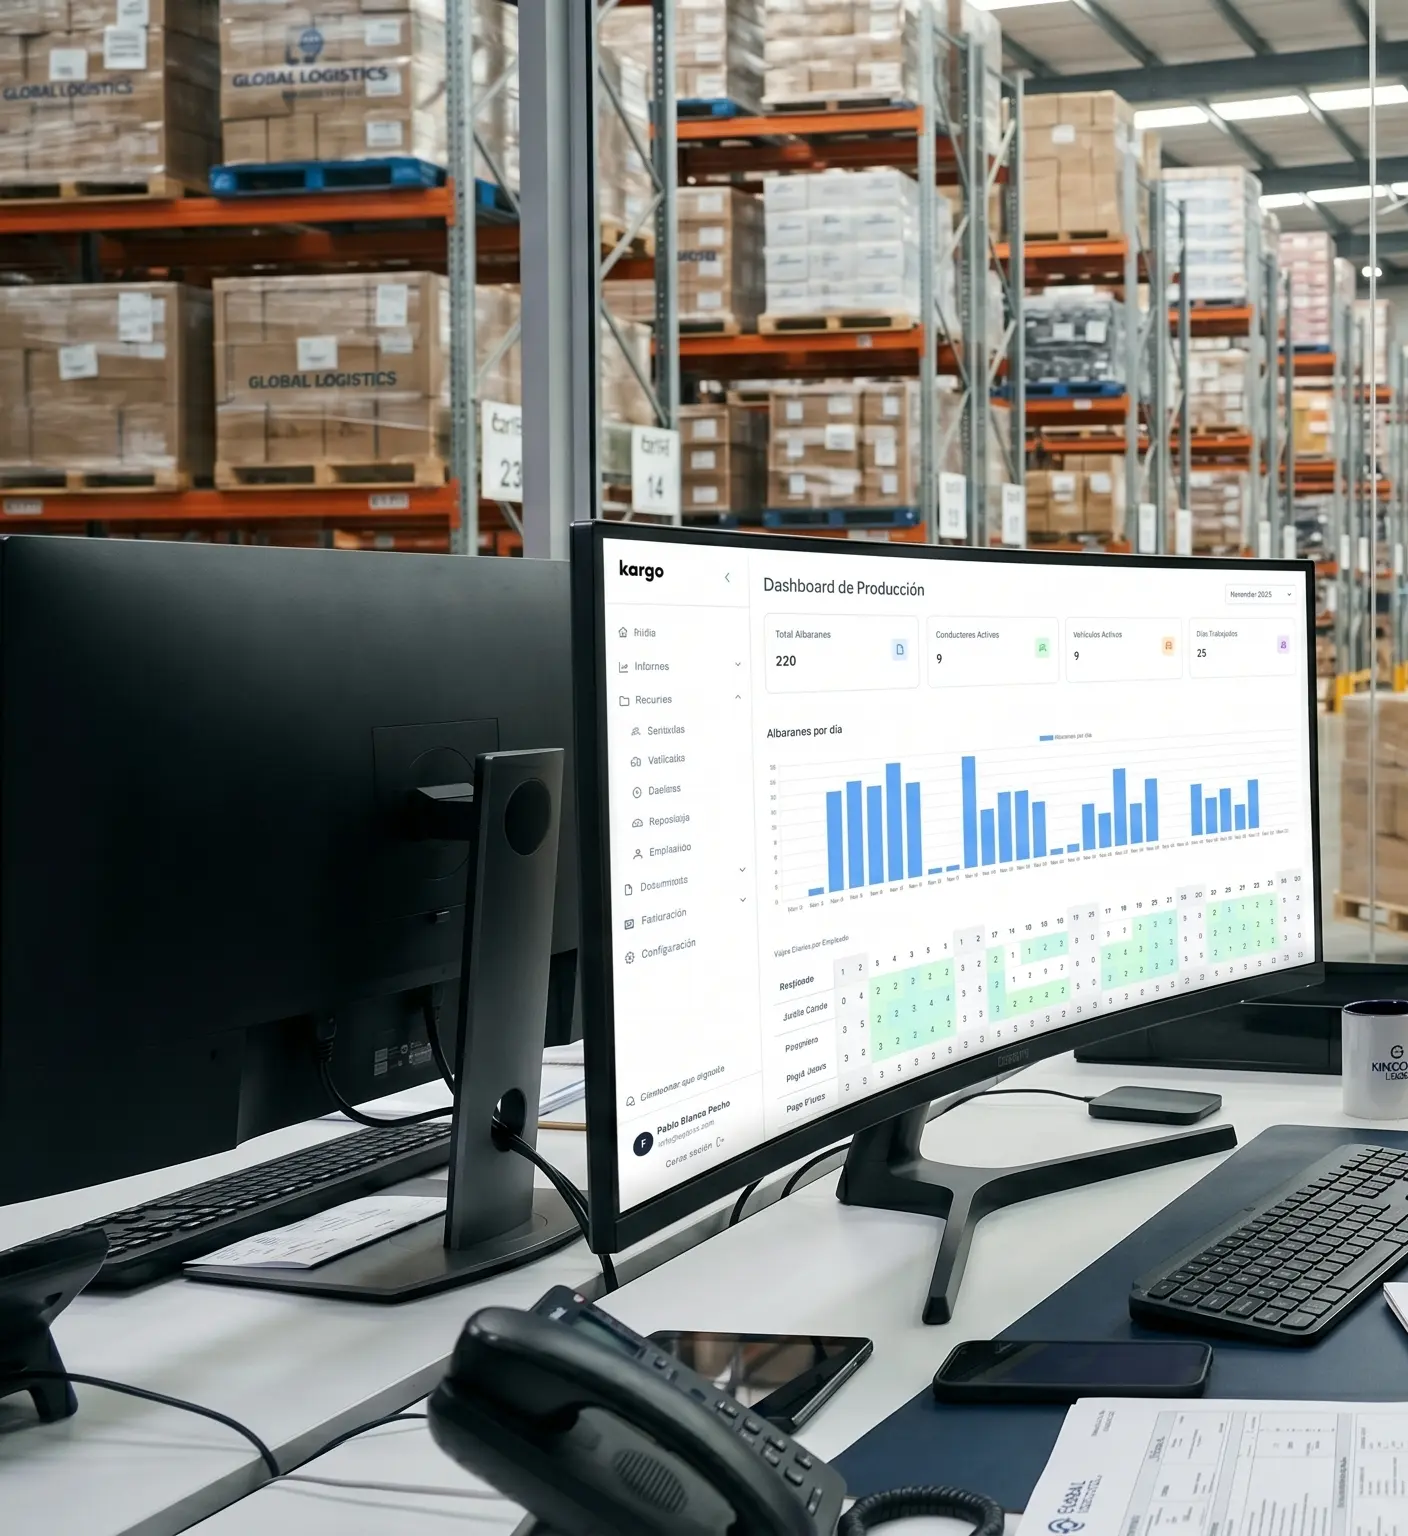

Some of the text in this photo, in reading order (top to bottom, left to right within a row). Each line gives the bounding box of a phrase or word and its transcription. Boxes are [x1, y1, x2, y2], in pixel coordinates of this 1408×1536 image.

[233, 66, 389, 88] GLOBAL LOGISTICS
[3, 79, 134, 101] GLOBAL LOGISTICS
[248, 371, 397, 389] GLOBAL LOGISTICS
[647, 474, 664, 500] 14
[619, 559, 664, 582] kargo
[764, 577, 925, 596] Dashboard de Producción
[1257, 590, 1273, 598] 2025
[775, 630, 832, 639] Total Albaranes
[775, 655, 797, 667] 220
[936, 653, 943, 664] 9
[1073, 651, 1080, 661] 9
[1196, 648, 1207, 658] 25
[766, 728, 812, 739] Albaranes
[813, 727, 828, 737] por
[858, 963, 863, 971] 2
[960, 938, 963, 946] 1
[841, 997, 846, 1005] 0
[859, 992, 864, 1000] 4
[876, 986, 881, 995] 2
[893, 982, 898, 990] 2
[945, 968, 949, 976] 2
[960, 964, 965, 972] 3
[977, 960, 981, 968] 2
[842, 1025, 848, 1034] 3
[860, 1019, 865, 1028] 5
[877, 1014, 882, 1023] 2
[844, 1054, 849, 1063] 3
[861, 1048, 866, 1056] 2
[895, 1037, 900, 1045] 2
[962, 1015, 967, 1023] 3
[1013, 1000, 1017, 1008] 2
[1029, 995, 1033, 1003] 2
[1061, 986, 1065, 994] 2
[845, 1083, 850, 1092] 3
[879, 1070, 884, 1079] 3
[897, 1064, 902, 1072] 5
[931, 1051, 936, 1060] 2
[979, 1035, 985, 1043] 3
[1045, 1015, 1050, 1023] 3
[1061, 1010, 1066, 1018] 2
[656, 1121, 680, 1135] Pablo
[707, 1100, 731, 1115] Pecho
[641, 1138, 647, 1149] F
